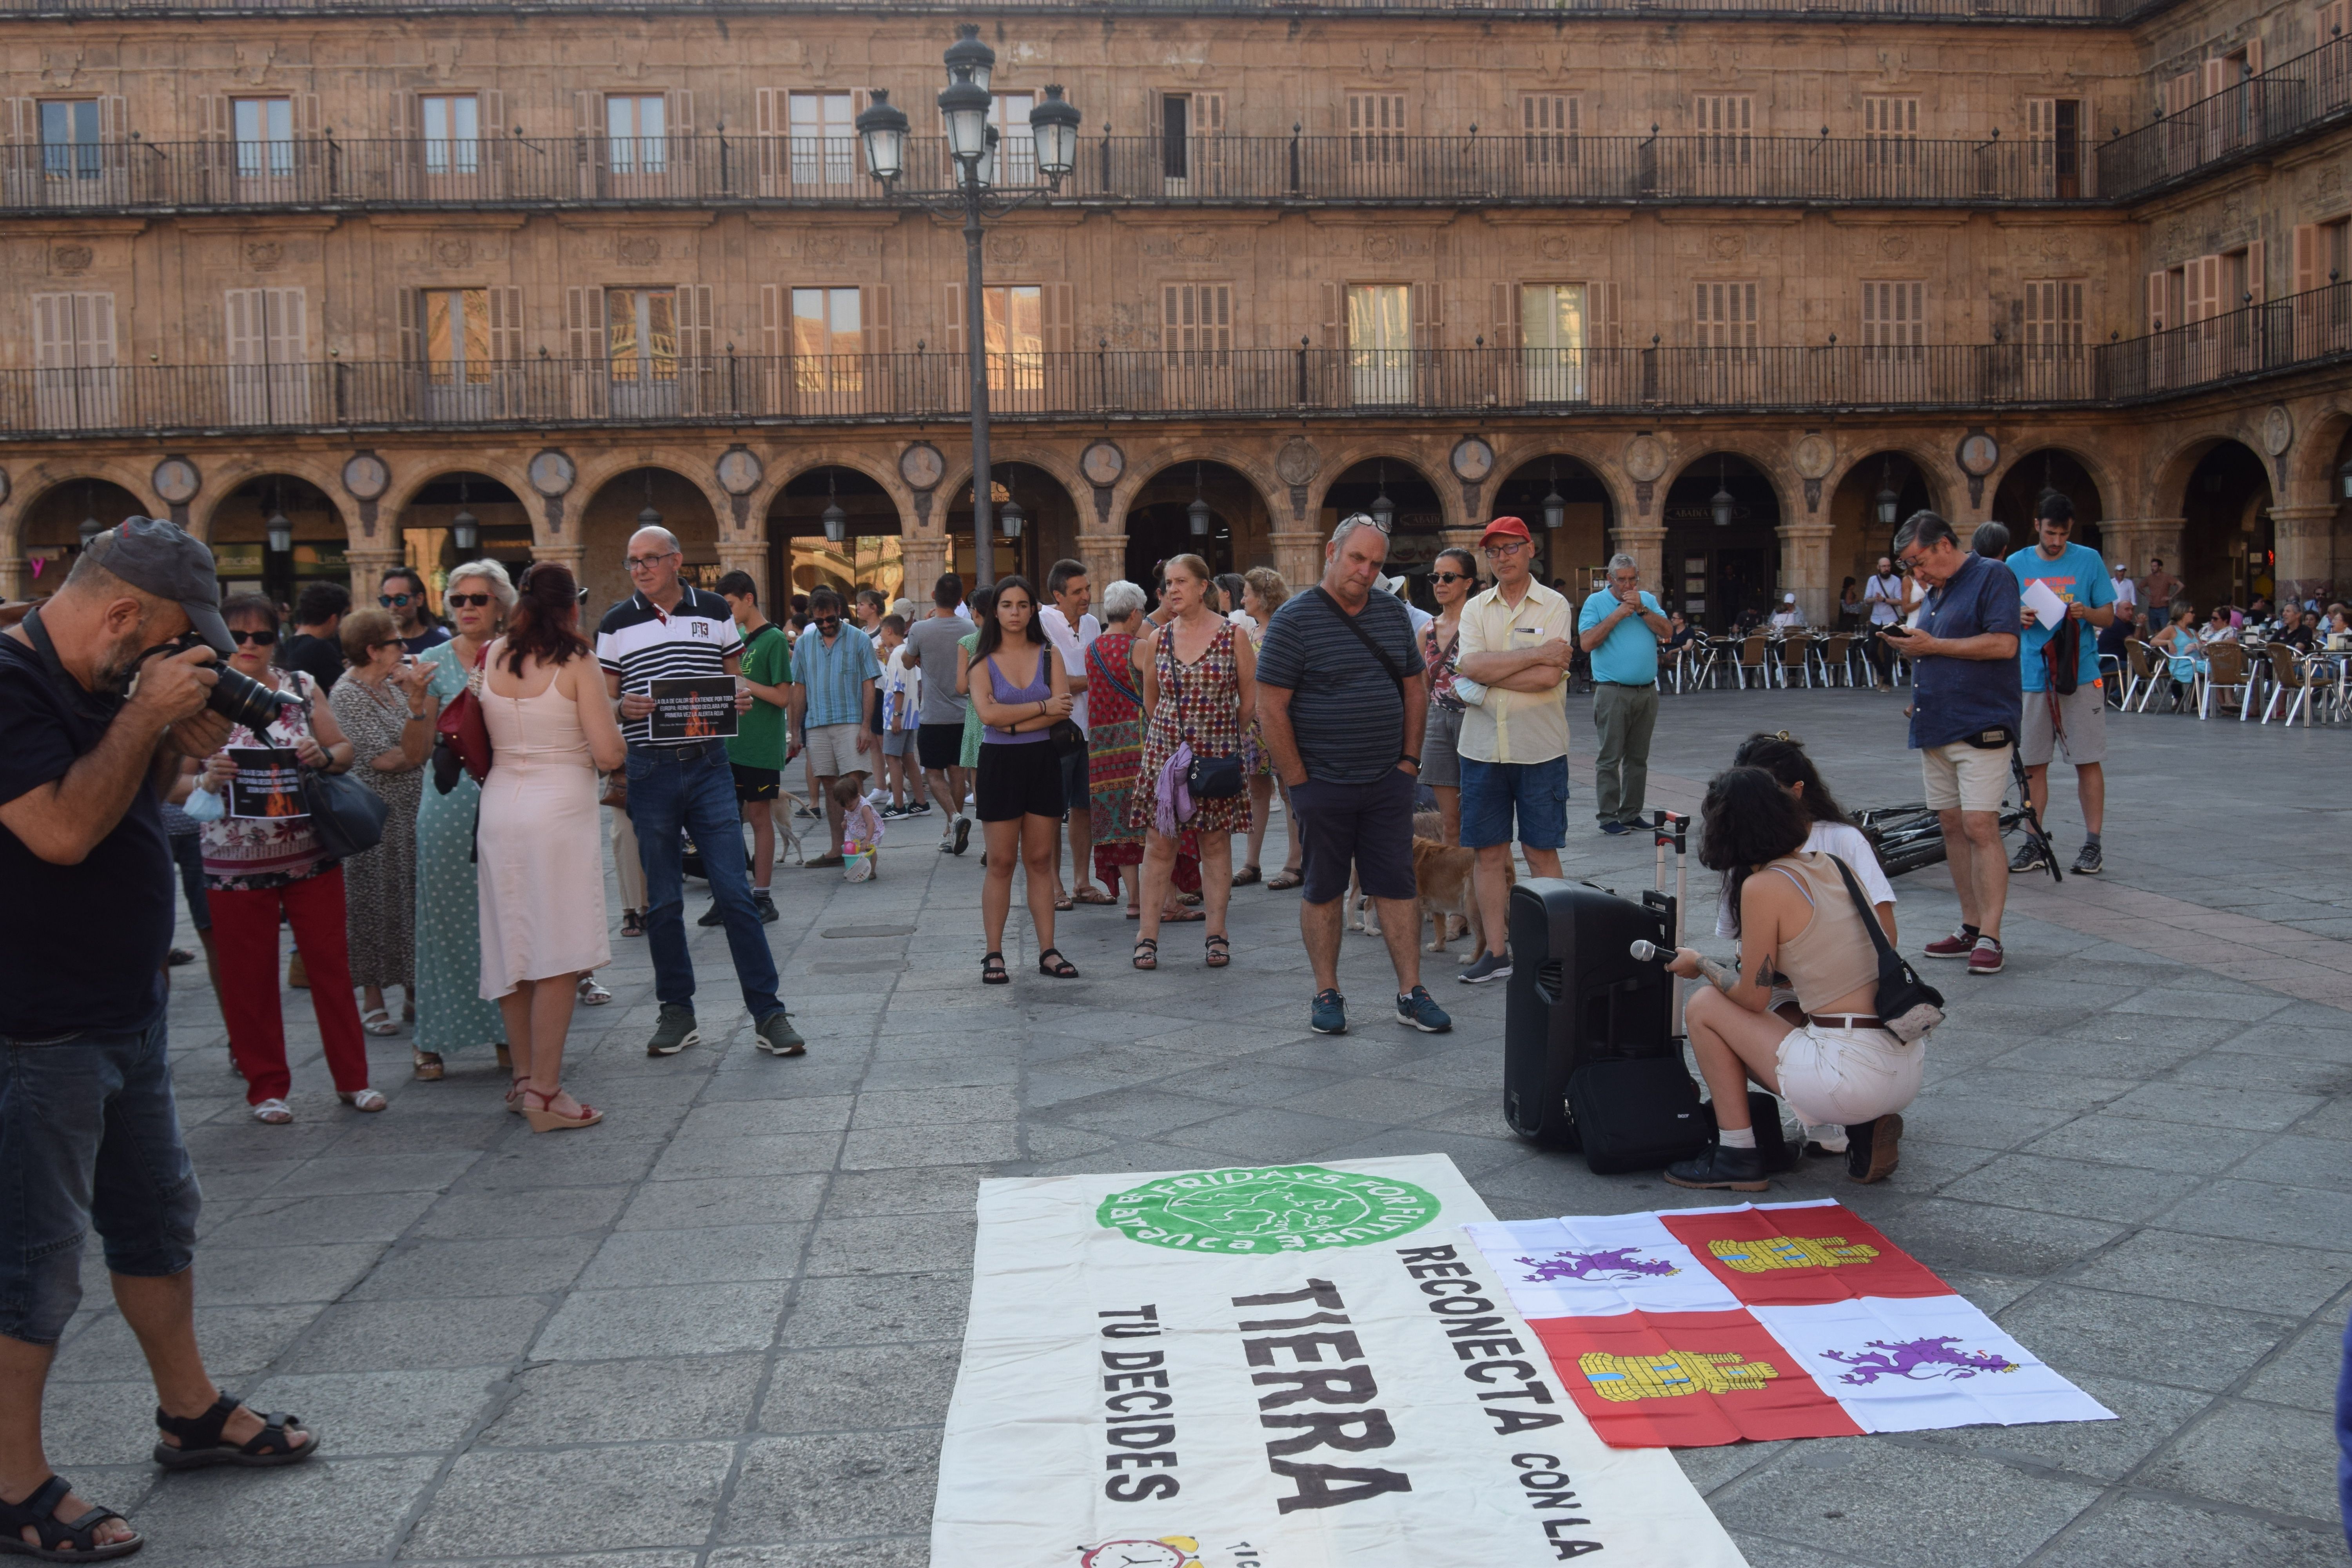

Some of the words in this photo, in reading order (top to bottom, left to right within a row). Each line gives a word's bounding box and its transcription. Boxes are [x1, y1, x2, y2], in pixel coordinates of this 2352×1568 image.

[1413, 515, 1441, 523] ABADÍ
[217, 555, 260, 566] imcasa
[1150, 1170, 1346, 1195] FRIDAYS
[1349, 1180, 1411, 1205] FOR
[1275, 1207, 1426, 1249] FUTURE
[1098, 1304, 1161, 1339] TU
[1397, 1245, 1563, 1435] RECONECTA
[1232, 1278, 1412, 1514] TIERRA
[1101, 1351, 1180, 1502] DECIDES
[1511, 1454, 1581, 1508] CON
[1542, 1518, 1604, 1561] LA
